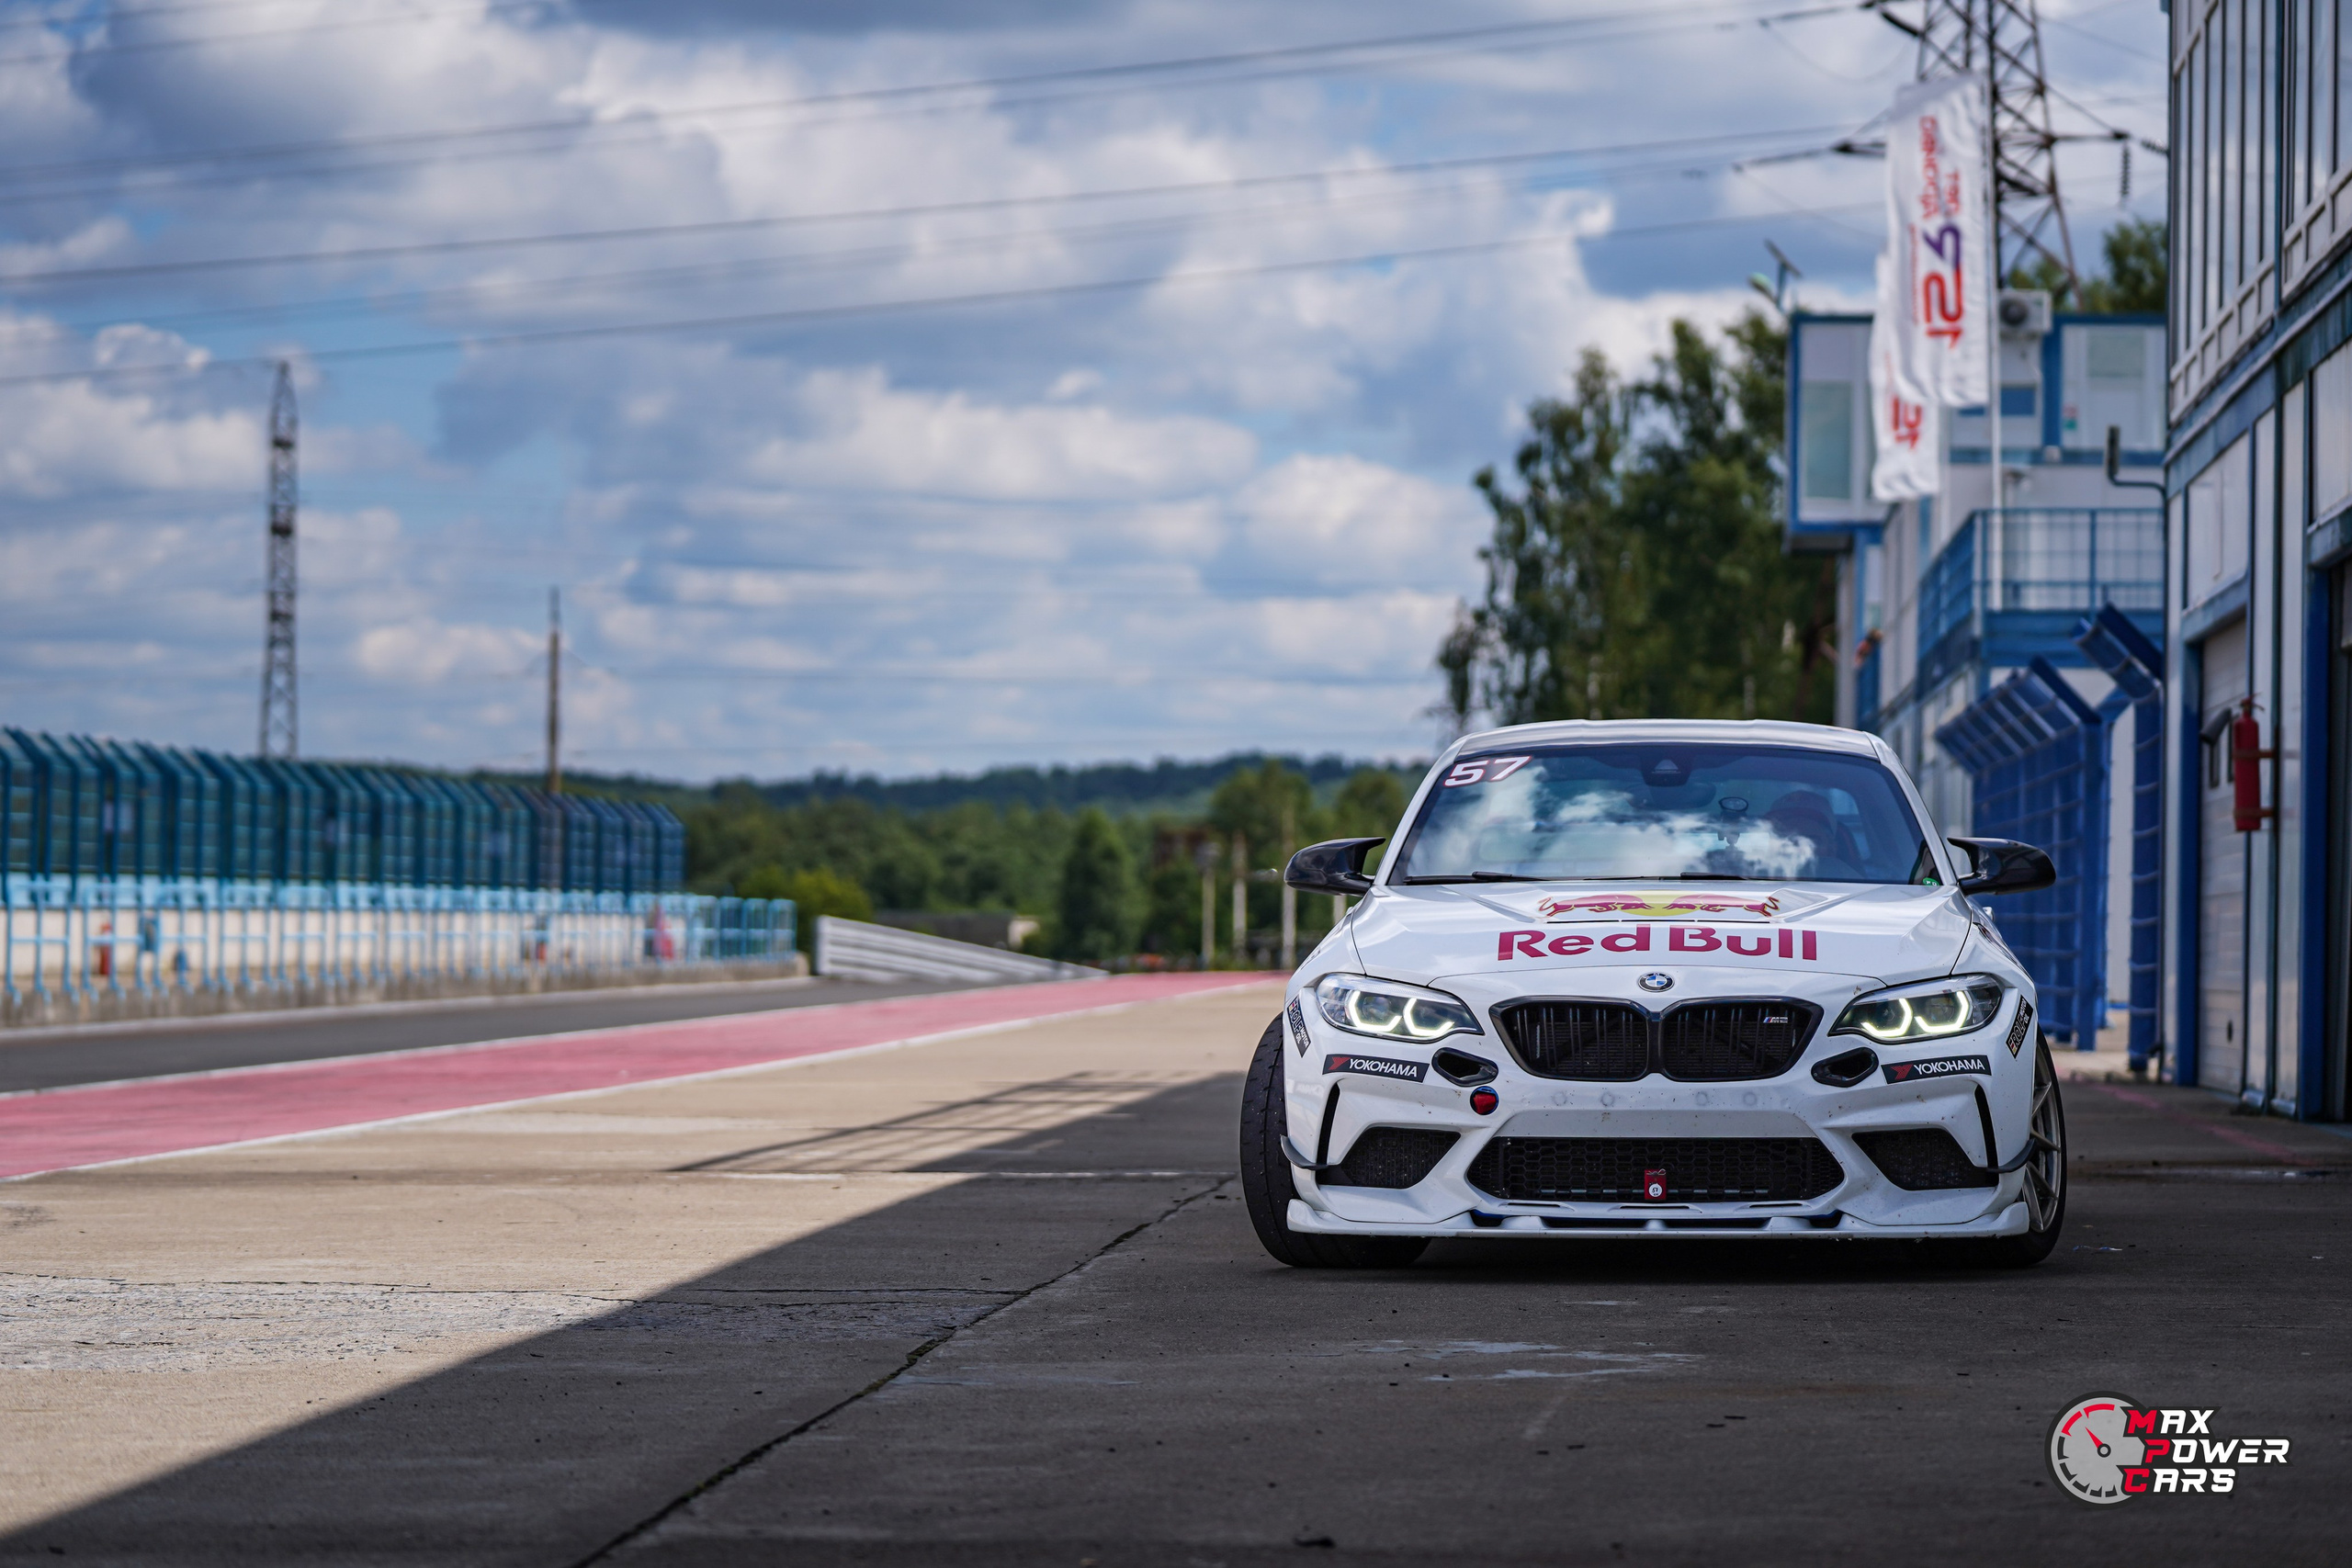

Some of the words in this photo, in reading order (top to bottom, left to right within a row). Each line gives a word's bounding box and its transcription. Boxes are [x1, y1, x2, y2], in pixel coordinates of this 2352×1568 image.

[1443, 755, 1532, 787] 57
[1498, 924, 1651, 961] Red
[1668, 924, 1817, 961] Bull
[1288, 1000, 1304, 1032] ROLF
[1349, 1058, 1418, 1077] YOKOHAMA
[1913, 1059, 1985, 1076] YOKOHAMA
